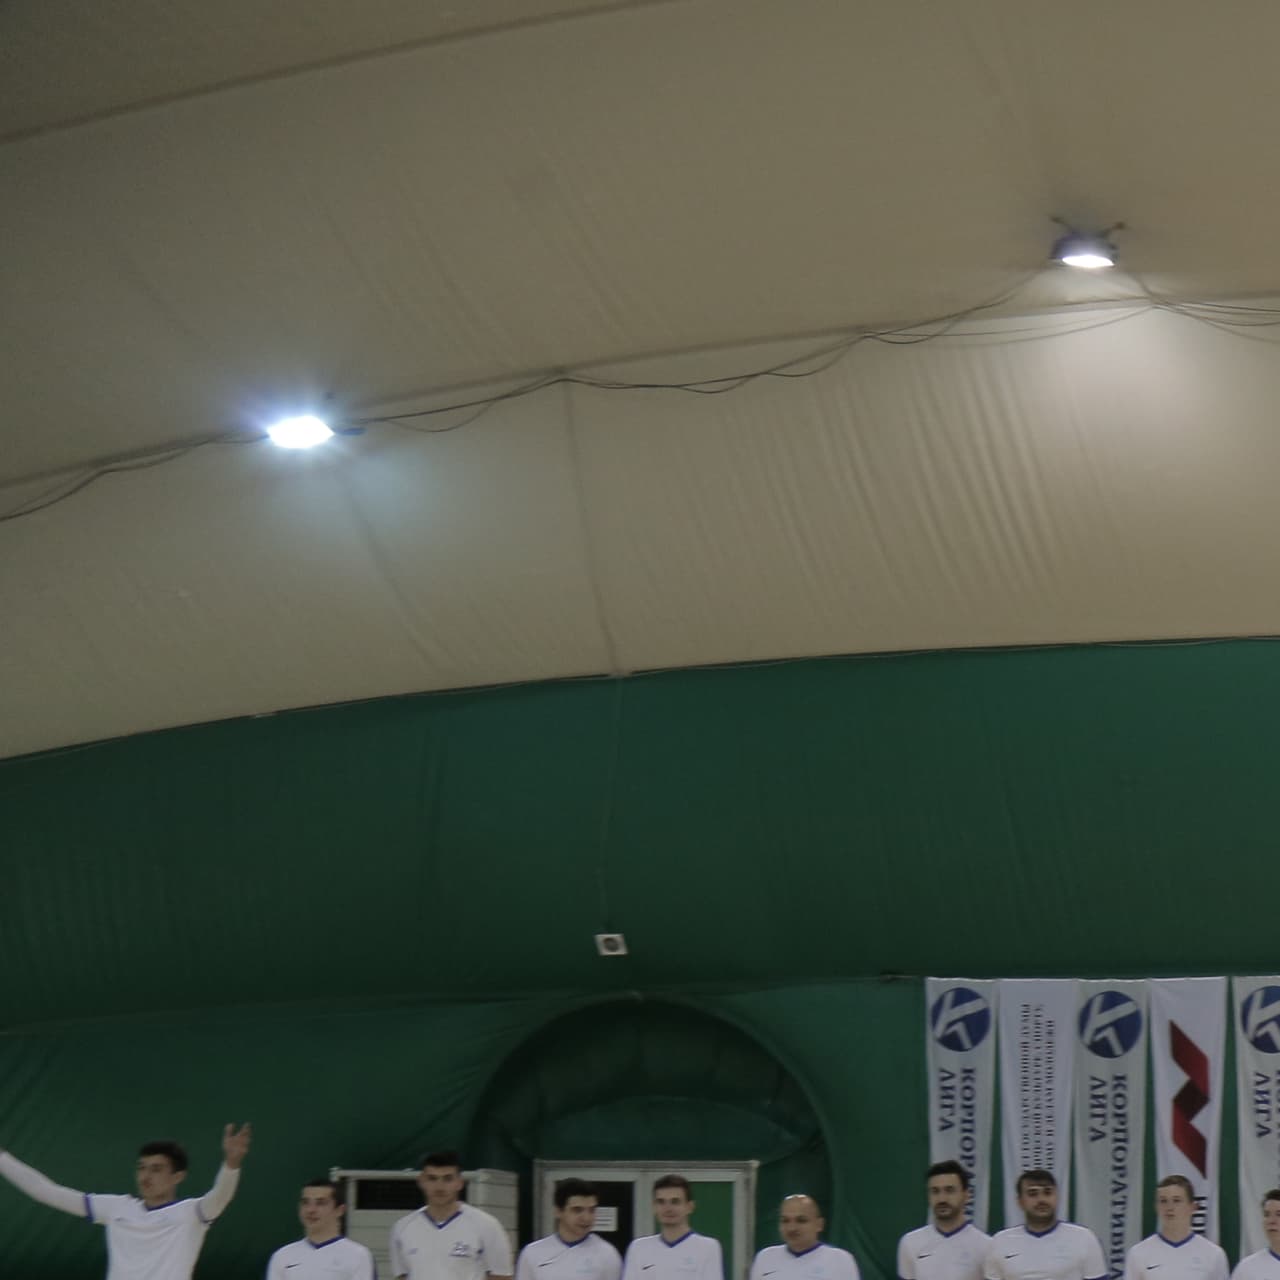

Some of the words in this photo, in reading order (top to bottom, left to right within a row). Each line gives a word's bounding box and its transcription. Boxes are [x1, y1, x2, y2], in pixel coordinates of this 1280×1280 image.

[938, 1067, 957, 1132] ЛИГА
[1089, 1075, 1108, 1143] ЛИГА
[1254, 1071, 1272, 1138] ЛИГА
